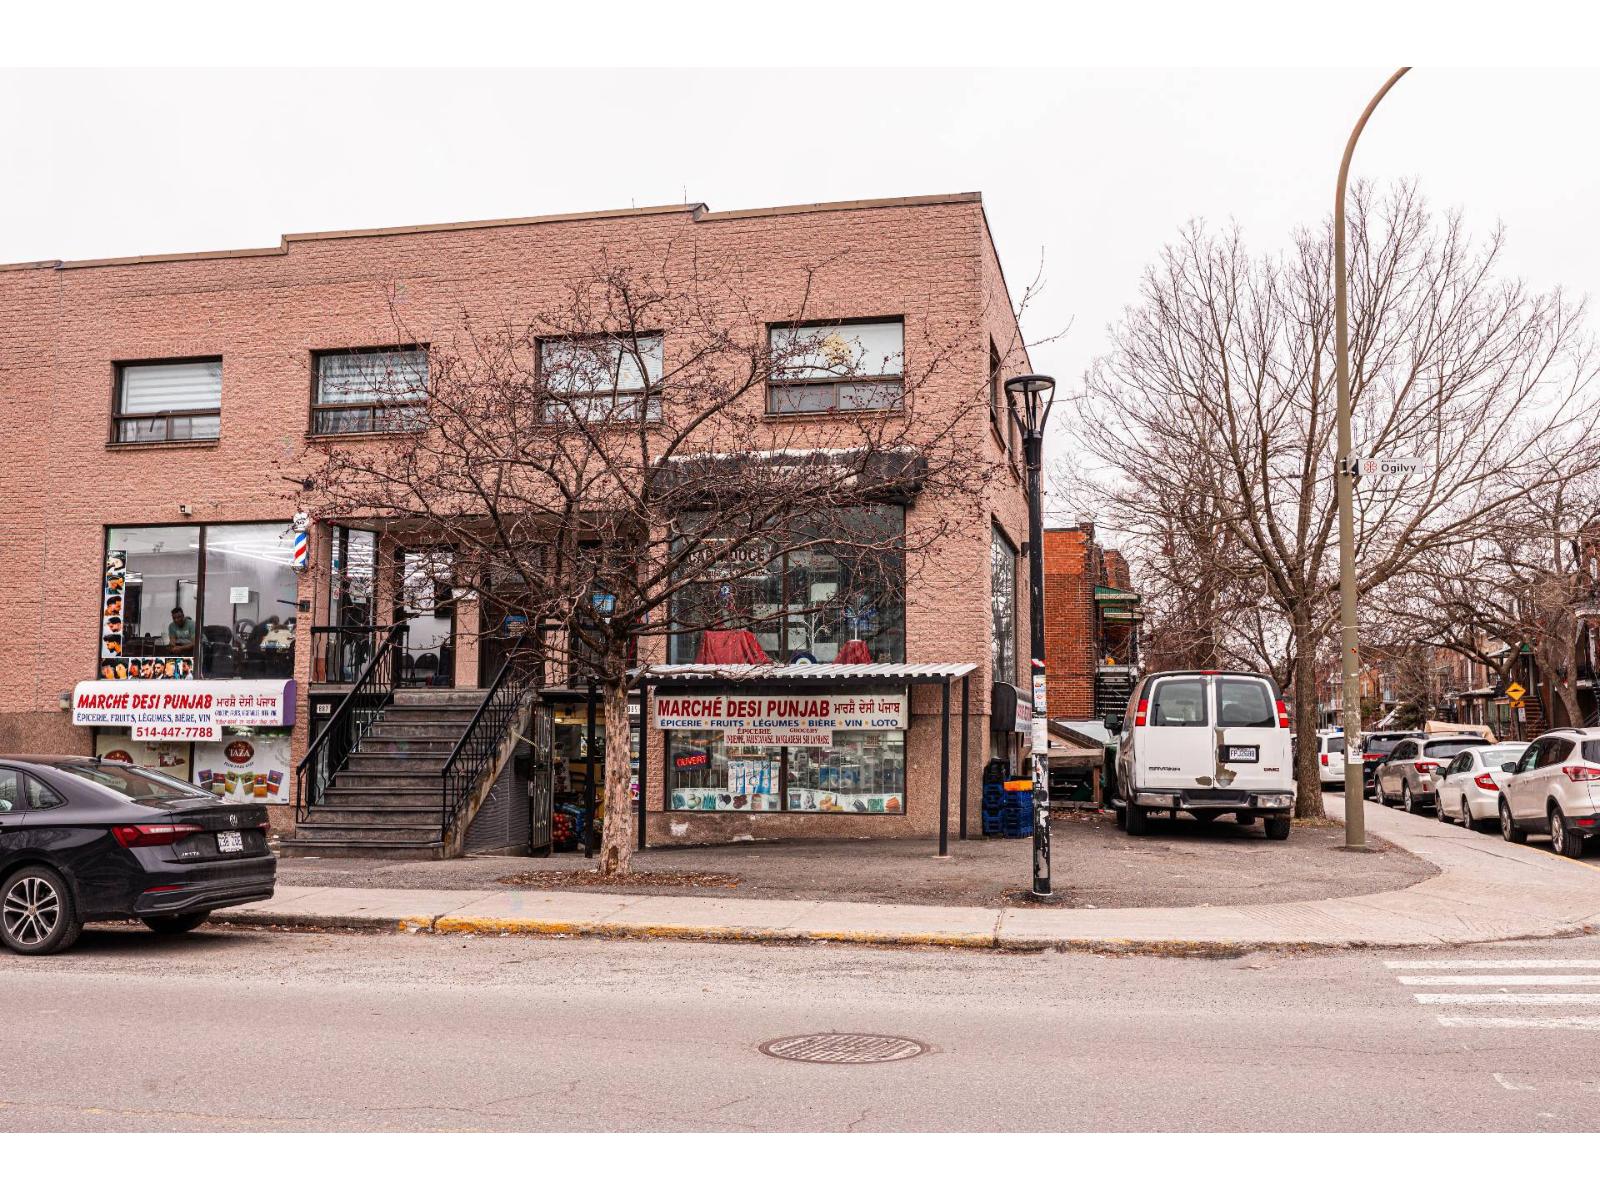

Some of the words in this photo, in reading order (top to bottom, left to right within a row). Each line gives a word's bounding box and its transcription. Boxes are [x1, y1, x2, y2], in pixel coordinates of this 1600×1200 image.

[1381, 463, 1416, 474] Ogilvy
[77, 692, 130, 709] MARCHÉ
[132, 694, 160, 709] DESI
[164, 694, 213, 709] PUNJAB
[657, 697, 723, 717] MARCHÉ
[726, 700, 762, 718] DESI
[767, 700, 830, 717] PUNJAB
[111, 713, 136, 723] FRUITS,
[138, 712, 173, 723] LÉGUMES,
[175, 713, 196, 723] BIÈRE,
[199, 714, 210, 722] VIN
[660, 718, 702, 727] ÉPICERIE
[753, 718, 800, 727] LÉGUMES
[808, 718, 836, 727] BIÈRE
[845, 719, 863, 727] VIN
[871, 719, 898, 727] LOTO
[136, 726, 213, 738] 514-447-7788
[228, 748, 250, 757] TAZA
[676, 754, 707, 768] OUVERT
